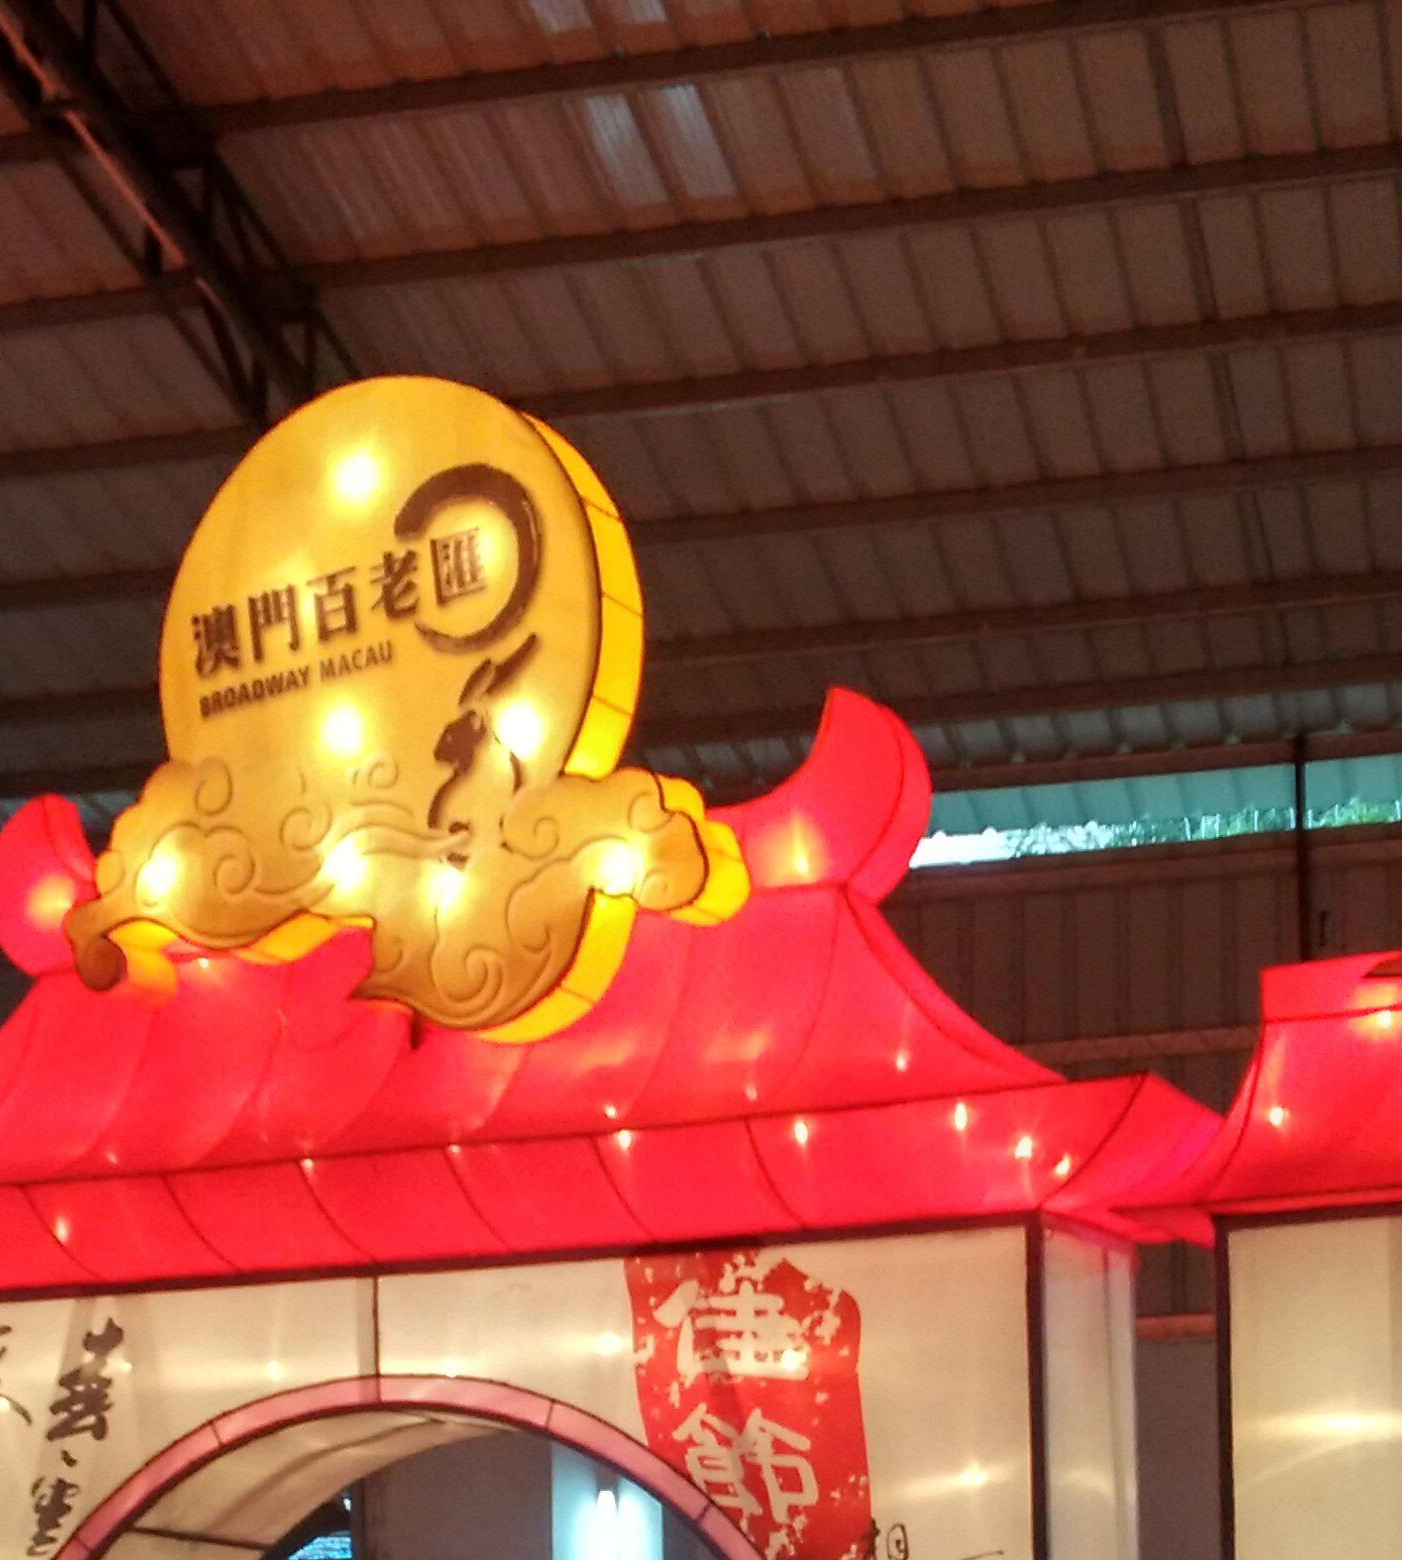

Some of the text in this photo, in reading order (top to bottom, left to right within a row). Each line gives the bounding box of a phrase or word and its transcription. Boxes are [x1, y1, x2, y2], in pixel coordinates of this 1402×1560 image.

[191, 527, 486, 678] 澳門百老匯
[199, 639, 394, 719] BROADWAY MACAU
